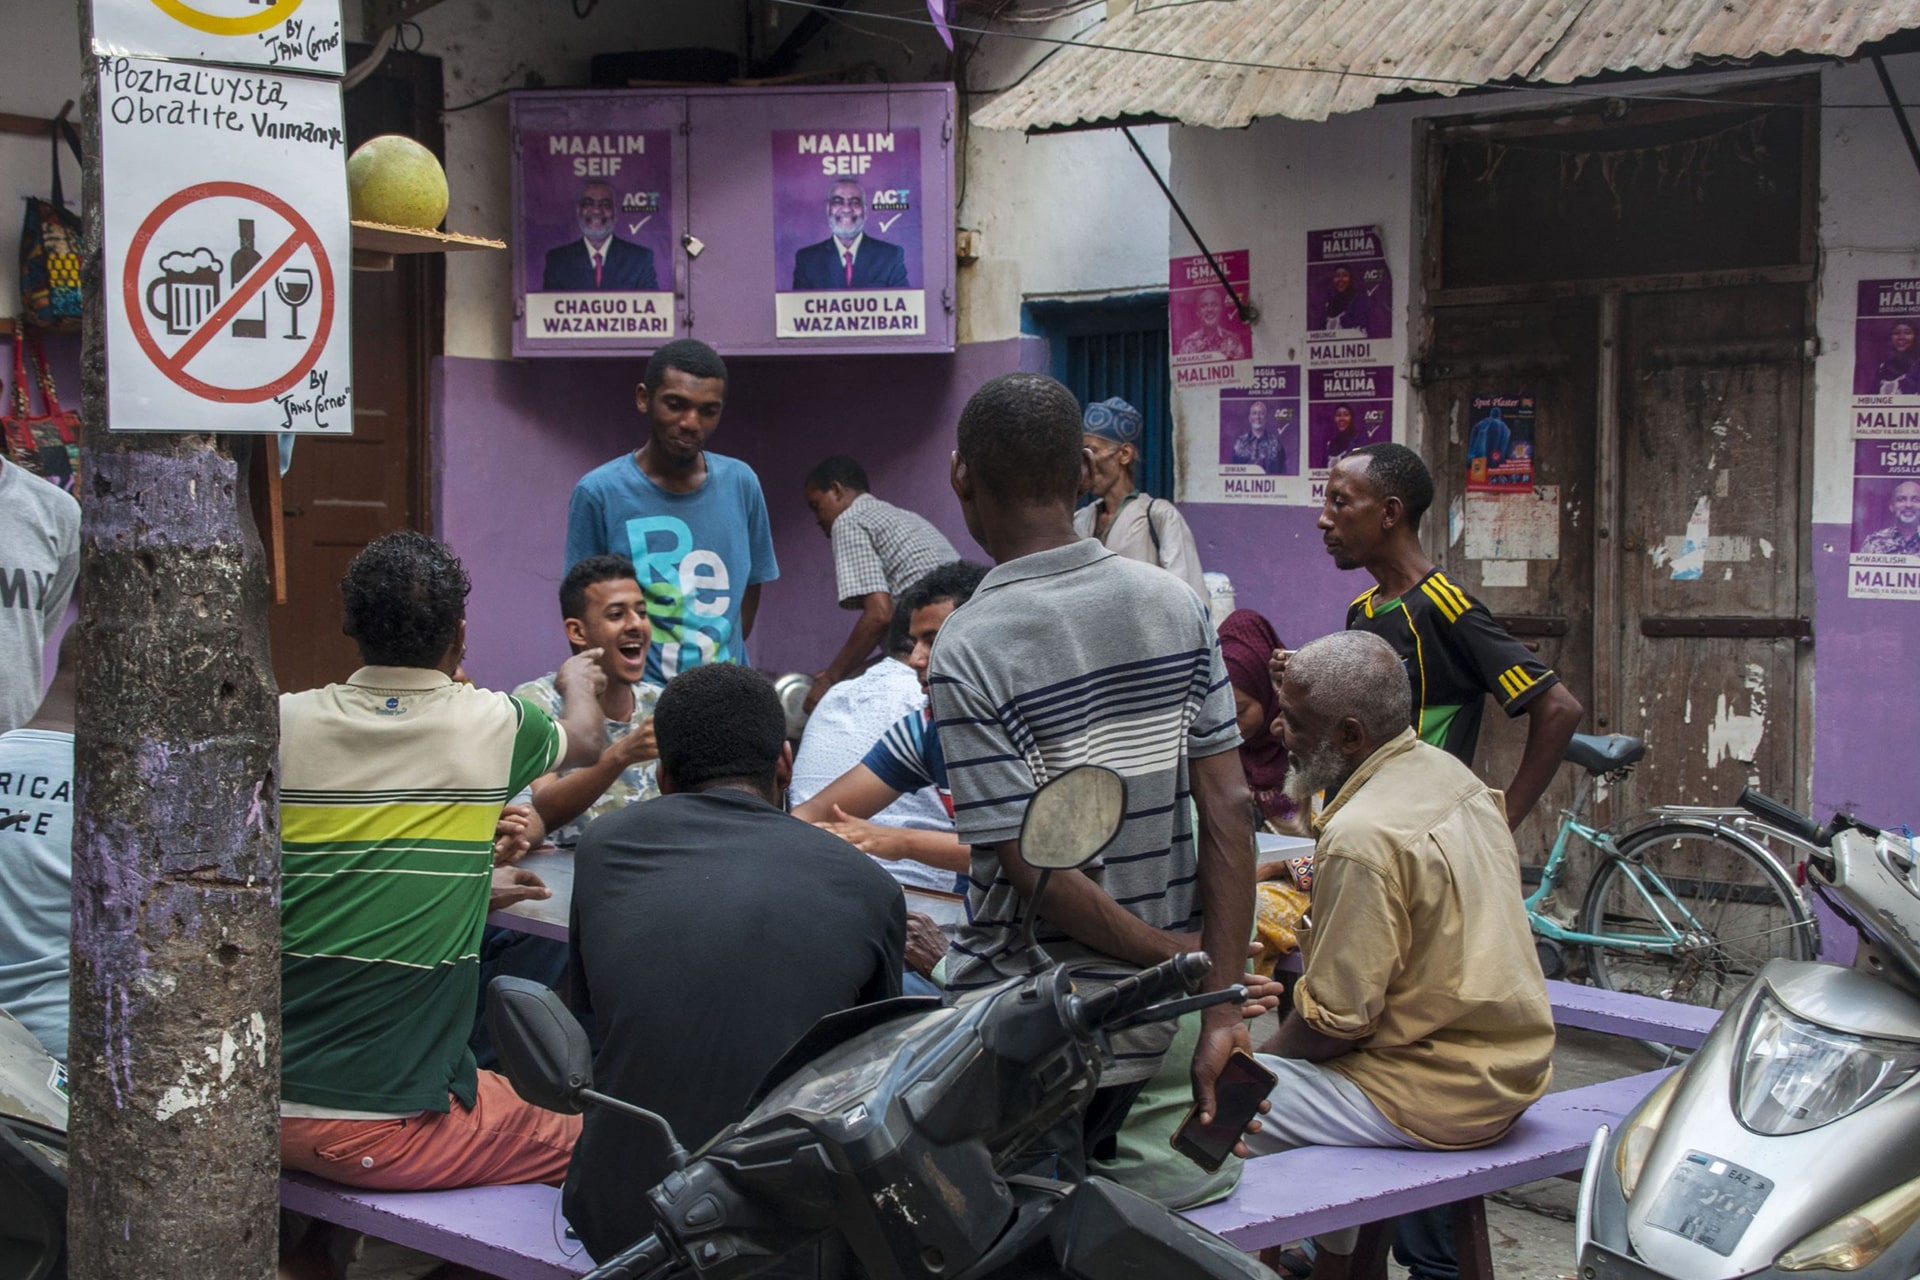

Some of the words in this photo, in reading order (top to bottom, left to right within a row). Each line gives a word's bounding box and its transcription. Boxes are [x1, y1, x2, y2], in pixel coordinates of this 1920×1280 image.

[286, 19, 303, 40] BY
[549, 135, 645, 155] MAALIM
[798, 132, 895, 154] MAALIM
[573, 157, 622, 176] SEIF
[821, 155, 872, 175] SEIF
[622, 192, 660, 207] ACT
[872, 189, 910, 205] ACT
[1332, 229, 1365, 239] CHAGUA
[1322, 237, 1375, 253] HALIMA
[1893, 281, 1920, 291] CHAG
[554, 300, 628, 314] CHAGUO
[633, 299, 656, 314] LA
[804, 298, 878, 314] CHAGUO
[883, 297, 907, 312] LA
[1879, 291, 1920, 306] HALI
[543, 317, 668, 333] WAZANZIBARI
[793, 315, 919, 332] WAZANZIBARI
[1310, 343, 1371, 360] MALINDI
[1176, 364, 1235, 383] MALINDI
[1333, 369, 1366, 378] CHAGUA
[309, 369, 328, 396] BY
[1323, 377, 1376, 392] HALIMA
[1858, 396, 1893, 405] MBUNGE
[1857, 412, 1919, 428] MALIN
[1891, 442, 1920, 451] CHAG
[1225, 479, 1275, 493] MALINDI
[1855, 570, 1920, 589] MALIN
